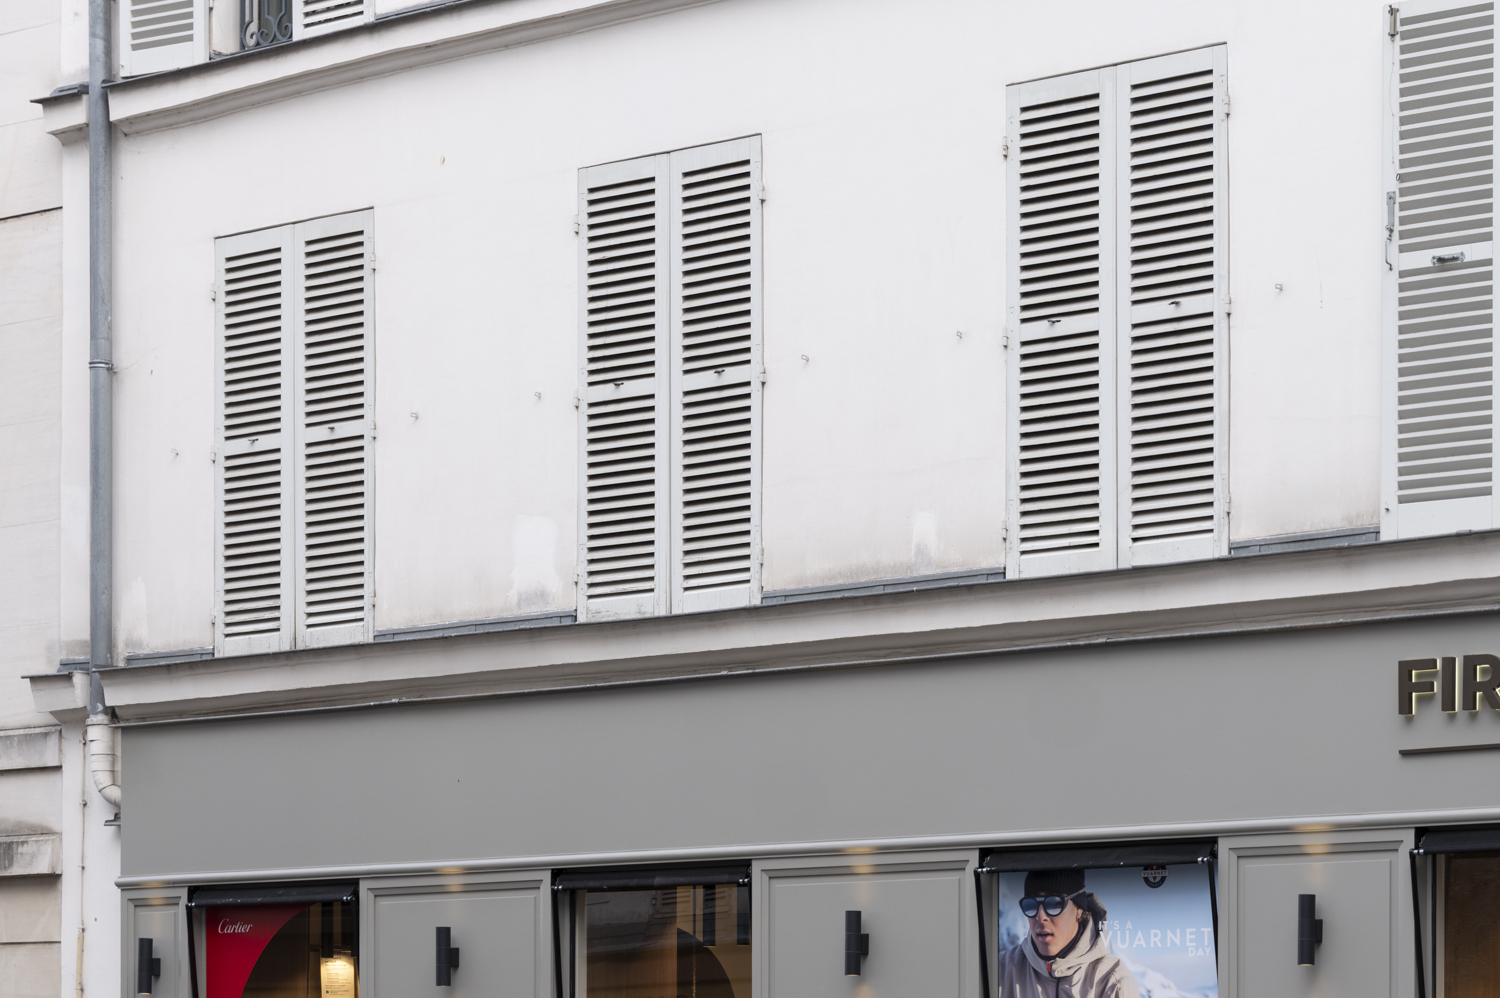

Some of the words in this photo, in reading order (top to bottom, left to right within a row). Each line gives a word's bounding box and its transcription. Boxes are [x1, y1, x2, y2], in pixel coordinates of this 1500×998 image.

[218, 918, 253, 934] Cartier
[1098, 920, 1120, 931] IT'S
[1125, 920, 1133, 930] A
[1099, 927, 1212, 949] VUARNET
[1188, 947, 1211, 957] DAY
